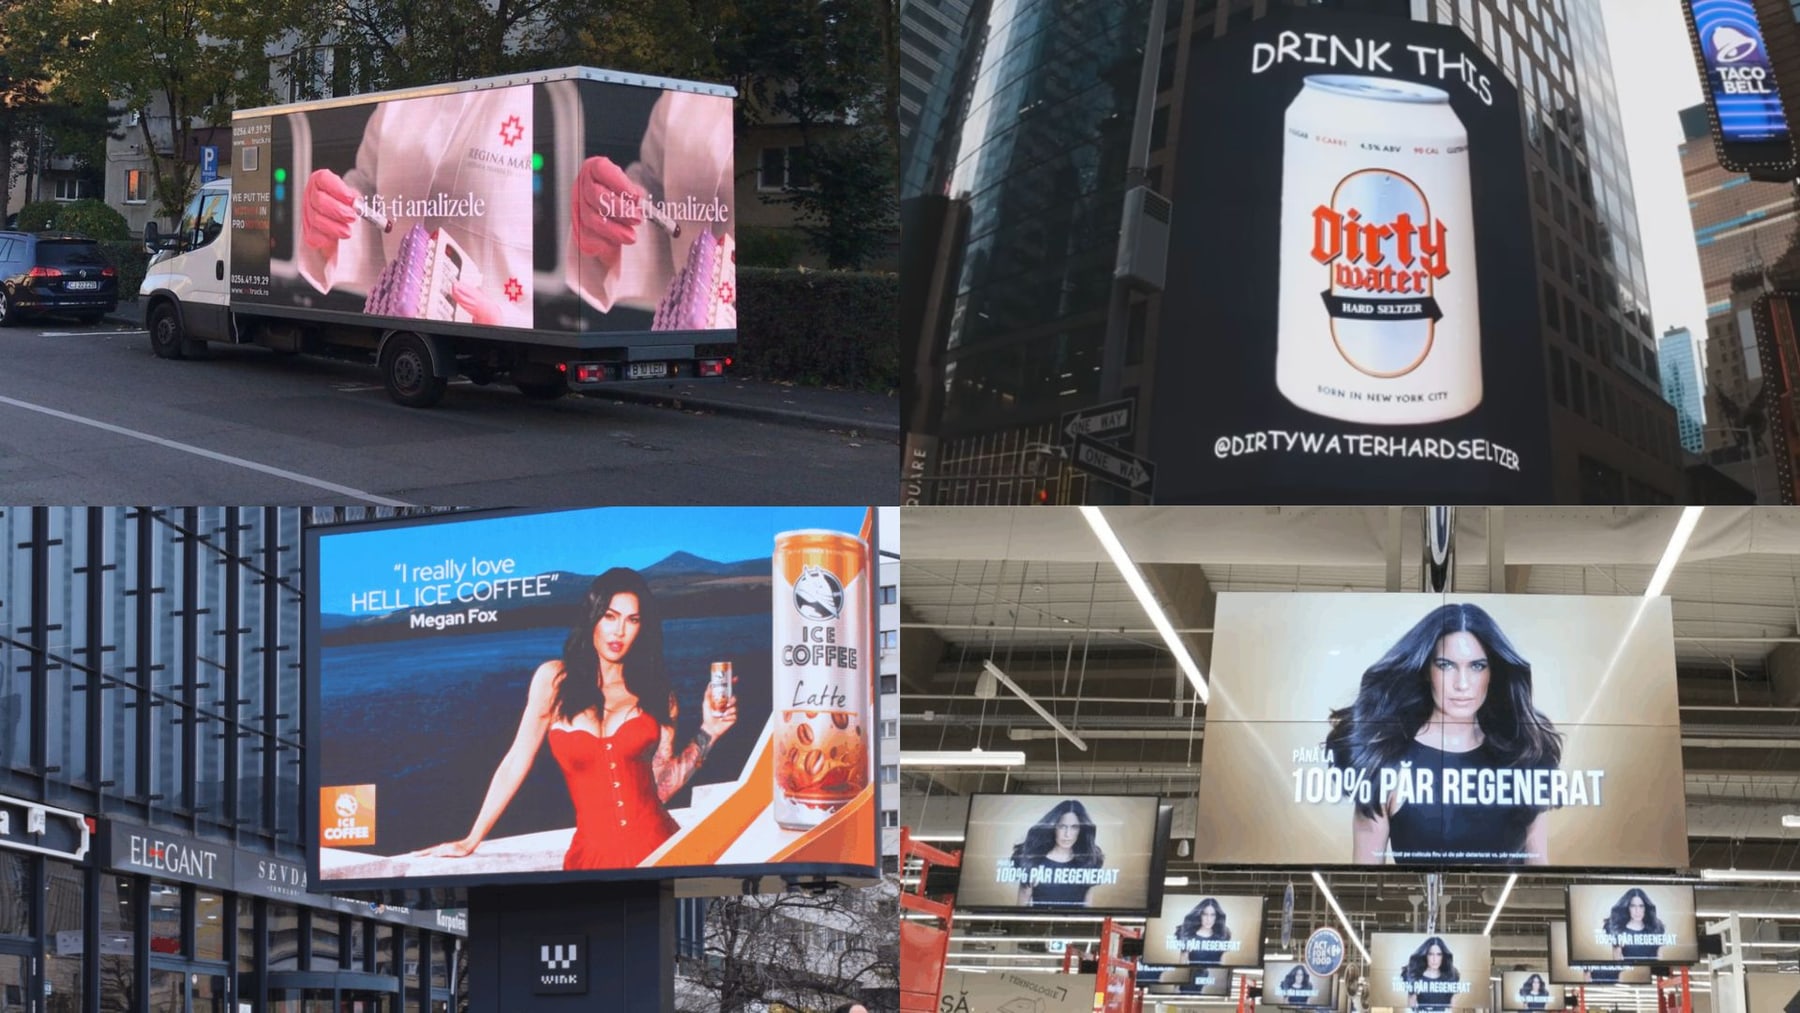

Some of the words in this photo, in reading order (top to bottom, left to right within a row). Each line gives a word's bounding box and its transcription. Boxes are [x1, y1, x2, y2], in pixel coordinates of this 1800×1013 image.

[1252, 30, 1393, 73] DRINK
[1406, 45, 1493, 106] THIS
[1716, 66, 1765, 81] TACO
[1723, 80, 1772, 94] BELL
[204, 147, 215, 171] P
[468, 148, 505, 165] REGINA
[232, 192, 242, 202] WE
[243, 192, 256, 202] PUT
[257, 192, 270, 202] THE
[406, 192, 486, 217] analizele
[599, 191, 616, 223] Și
[656, 195, 729, 222] analizele
[1311, 204, 1450, 280] Dirty
[231, 274, 269, 285] 0256.49.39.29
[1336, 263, 1428, 294] water
[1342, 303, 1374, 314] HARD
[1377, 304, 1422, 315] SELTZER
[1317, 385, 1345, 397] BORN
[1350, 391, 1362, 400] IN
[1367, 394, 1392, 402] NEW
[1396, 395, 1424, 403] YORK
[1428, 391, 1448, 400] CITY
[1070, 418, 1091, 434] ONE
[1102, 411, 1123, 428] WAY
[1214, 430, 1520, 471] @DIRTYWATERHARDSELTZER
[1086, 448, 1108, 468] ONE
[1120, 463, 1142, 483] WAY
[412, 560, 467, 584] really
[471, 557, 516, 577] love
[351, 589, 409, 612] HELL
[414, 584, 451, 607] ICE
[409, 612, 466, 631] Megan
[467, 609, 498, 625] Fox
[802, 626, 836, 644] ICE
[782, 644, 857, 670] COFFEE
[792, 679, 847, 708] Latte
[1321, 748, 1334, 763] LA
[1292, 766, 1372, 804] 100%
[1379, 760, 1434, 805] PĂR
[1442, 767, 1605, 807] REGENERAT
[323, 826, 370, 840] COFFEE
[337, 818, 355, 828] ICE
[130, 834, 217, 880] ELEGANT
[258, 860, 308, 889] SEVDA
[996, 867, 1028, 883] 100%
[1029, 864, 1053, 884] PĂR
[1054, 867, 1120, 885] REGENERAT
[1314, 941, 1328, 950] ACT
